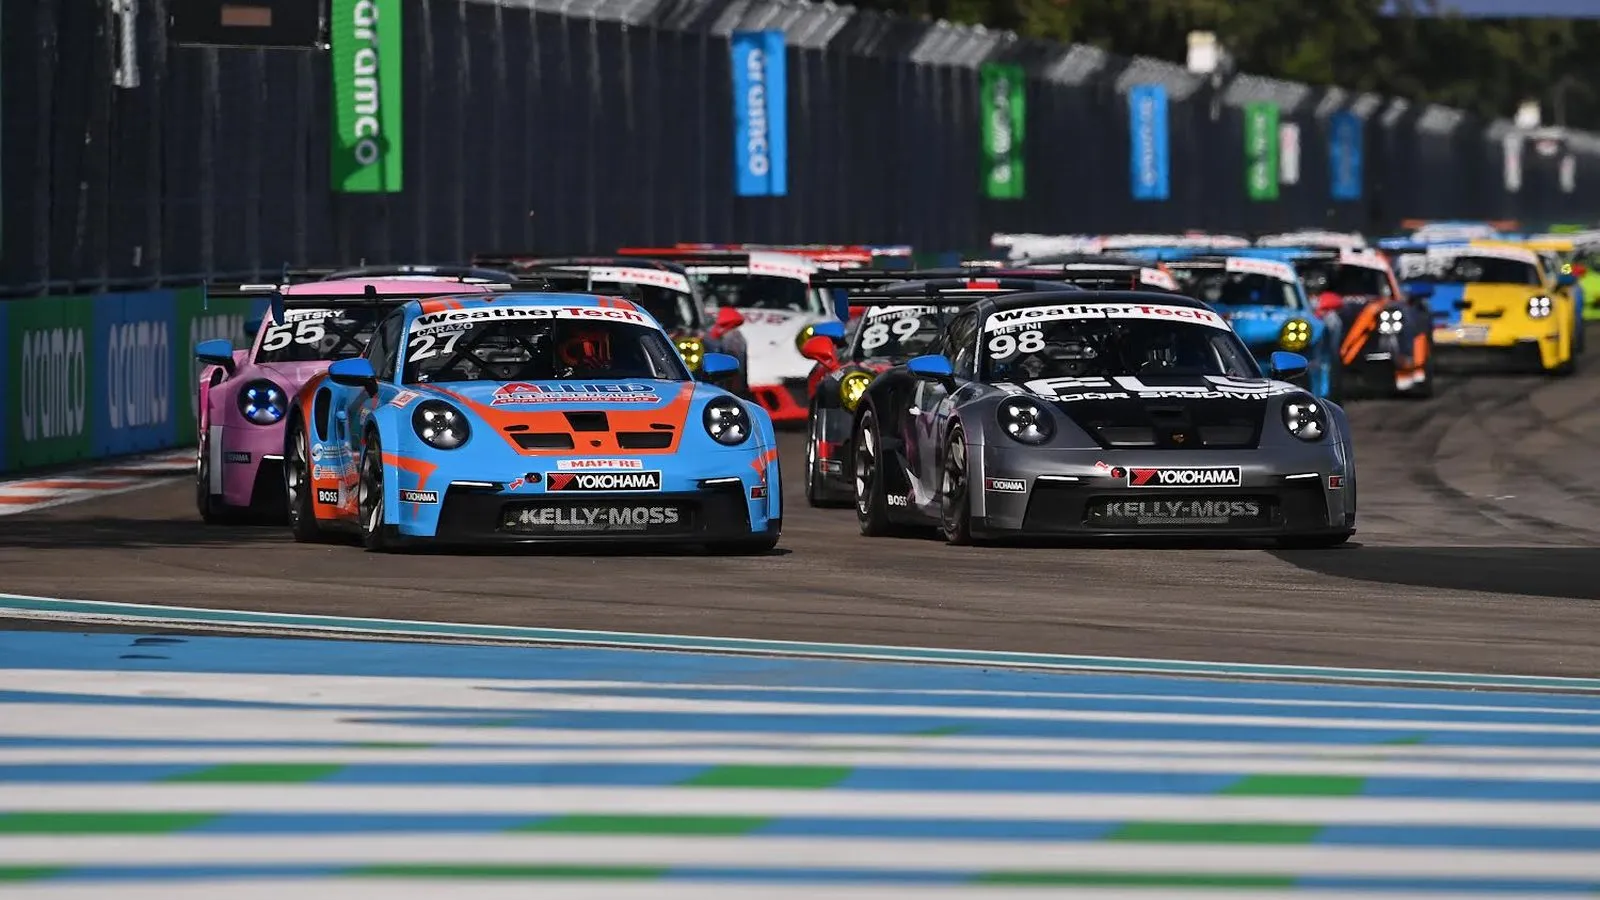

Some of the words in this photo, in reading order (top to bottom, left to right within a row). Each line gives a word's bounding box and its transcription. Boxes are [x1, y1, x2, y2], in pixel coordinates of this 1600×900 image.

[354, 0, 379, 165] aramco
[417, 307, 644, 326] WeatherTech
[994, 305, 1213, 322] WeatherTech
[262, 319, 326, 352] 55
[416, 321, 474, 337] CARAZO
[861, 318, 921, 350] 89
[993, 322, 1042, 337] METNI
[408, 330, 466, 363] 27
[988, 330, 1046, 360] 98
[108, 320, 169, 429] aramco
[21, 327, 86, 441] aramco
[492, 381, 656, 395] ALLIED
[570, 460, 641, 468] MAPFRE
[575, 474, 656, 489] YOKOHAMA
[1157, 470, 1236, 484] YOKOHAMA
[319, 490, 338, 503] BOSS
[887, 494, 908, 506] BOSS
[519, 507, 679, 525] KELLY-MOSS
[1106, 501, 1261, 517] KELLY-MOSS
